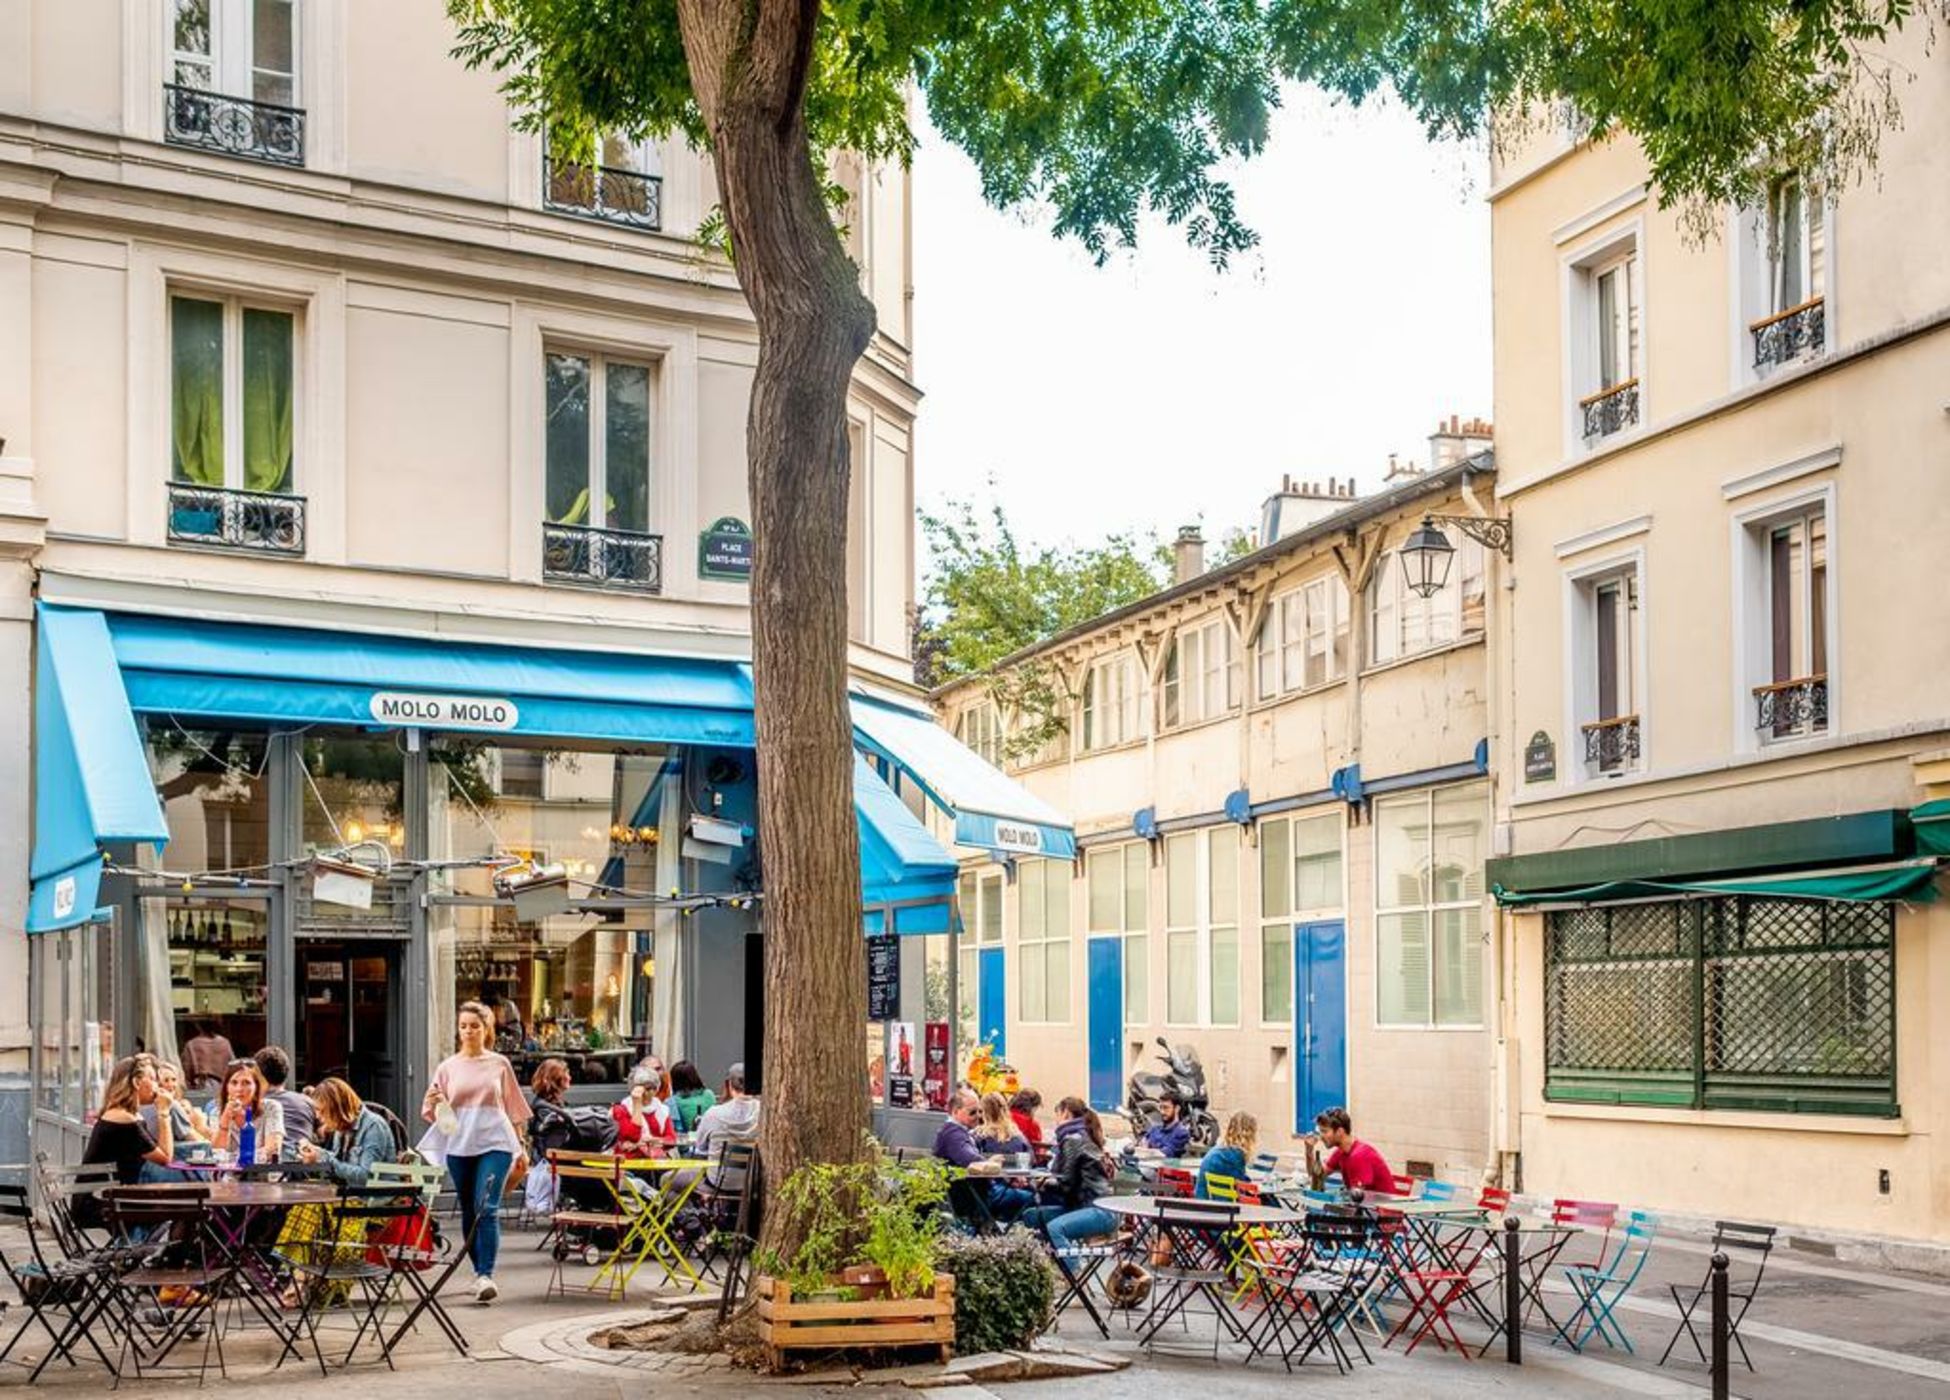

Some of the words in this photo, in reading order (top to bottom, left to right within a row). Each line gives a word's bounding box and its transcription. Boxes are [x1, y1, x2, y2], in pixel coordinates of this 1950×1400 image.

[721, 542, 742, 553] PLACE
[705, 554, 752, 566] SAINTE-MART
[382, 699, 439, 719] MOLO
[450, 703, 506, 723] MOLO
[998, 826, 1018, 844] MOLO
[1019, 829, 1039, 847] MOLO
